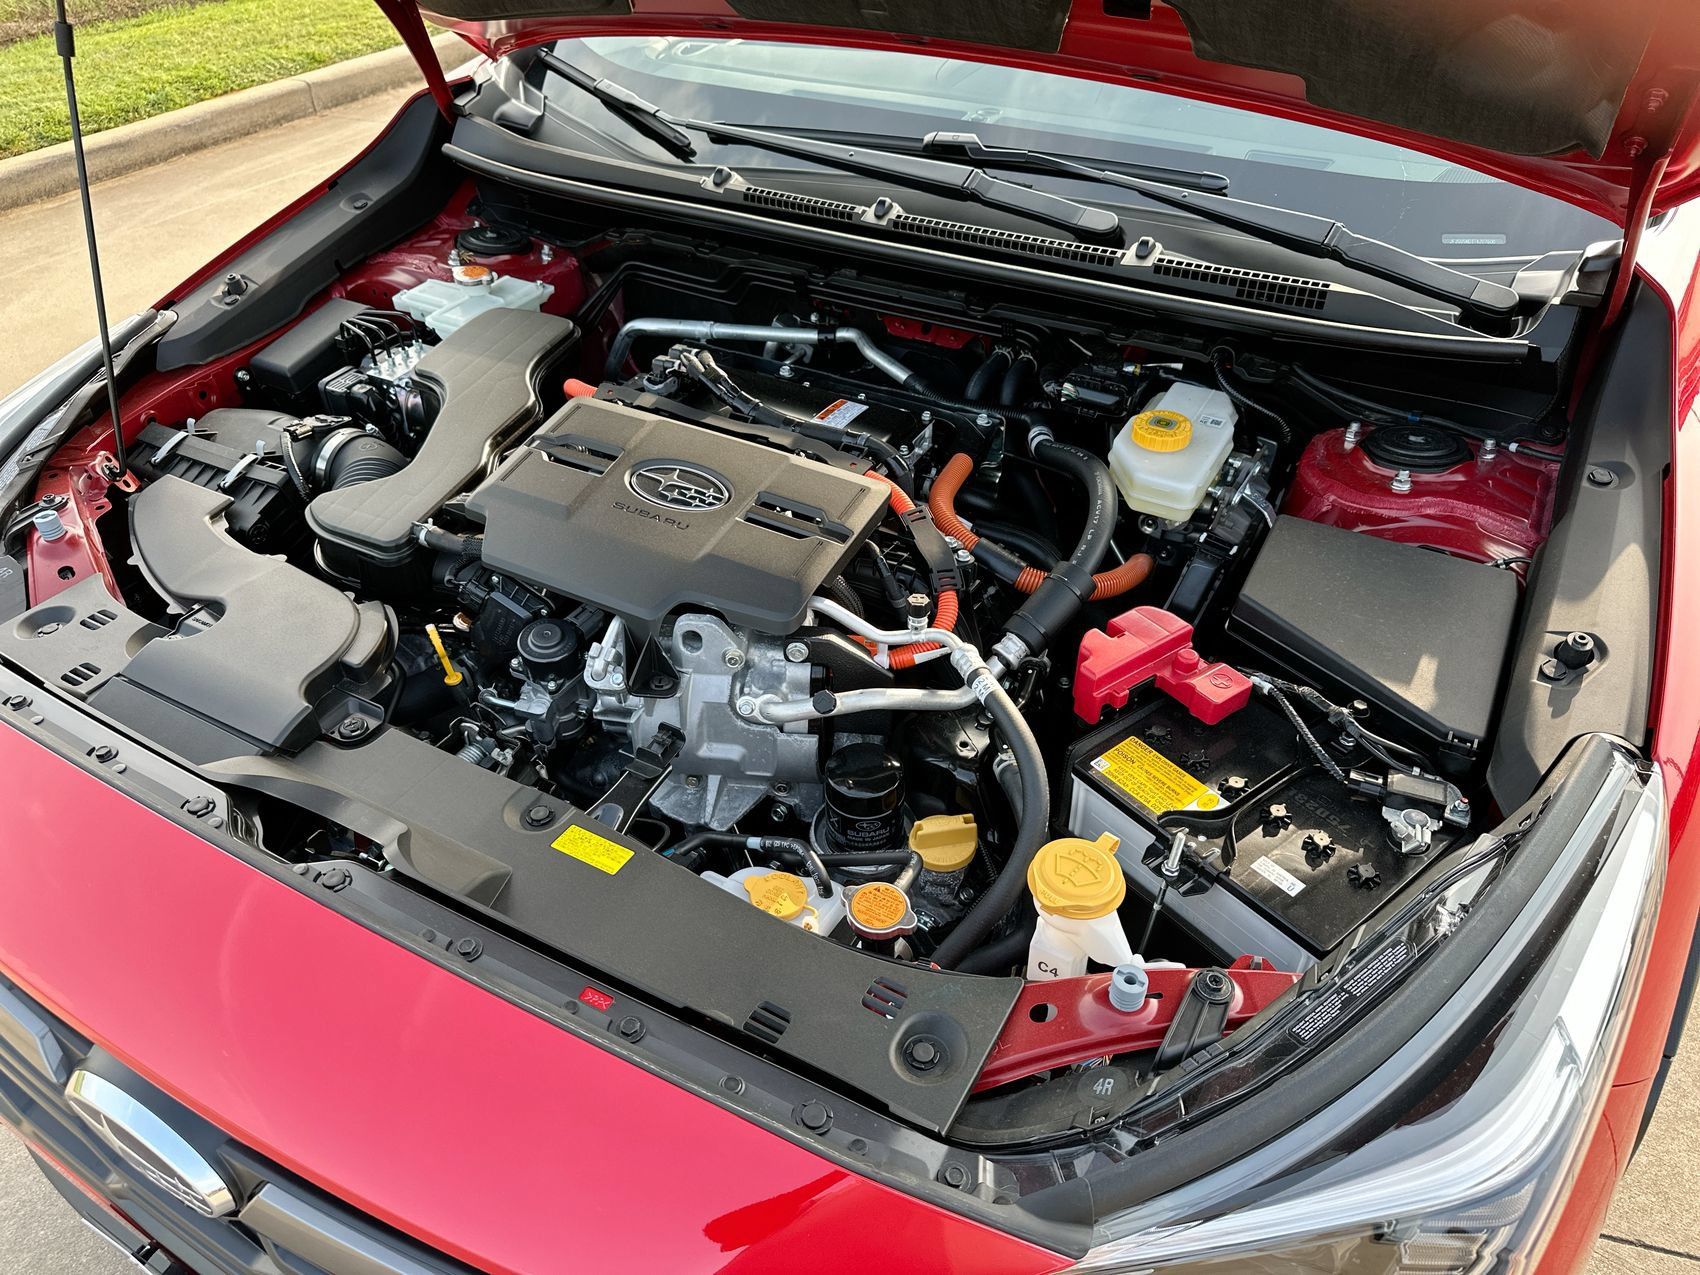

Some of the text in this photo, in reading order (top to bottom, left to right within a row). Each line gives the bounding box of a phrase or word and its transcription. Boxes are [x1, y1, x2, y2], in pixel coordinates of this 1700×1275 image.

[612, 501, 690, 531] SUBARU
[1129, 738, 1153, 754] DANGER
[1113, 748, 1136, 764] POISON
[847, 826, 890, 838] SUBARU
[1038, 961, 1059, 977] C4
[1093, 1078, 1114, 1096] 4R
